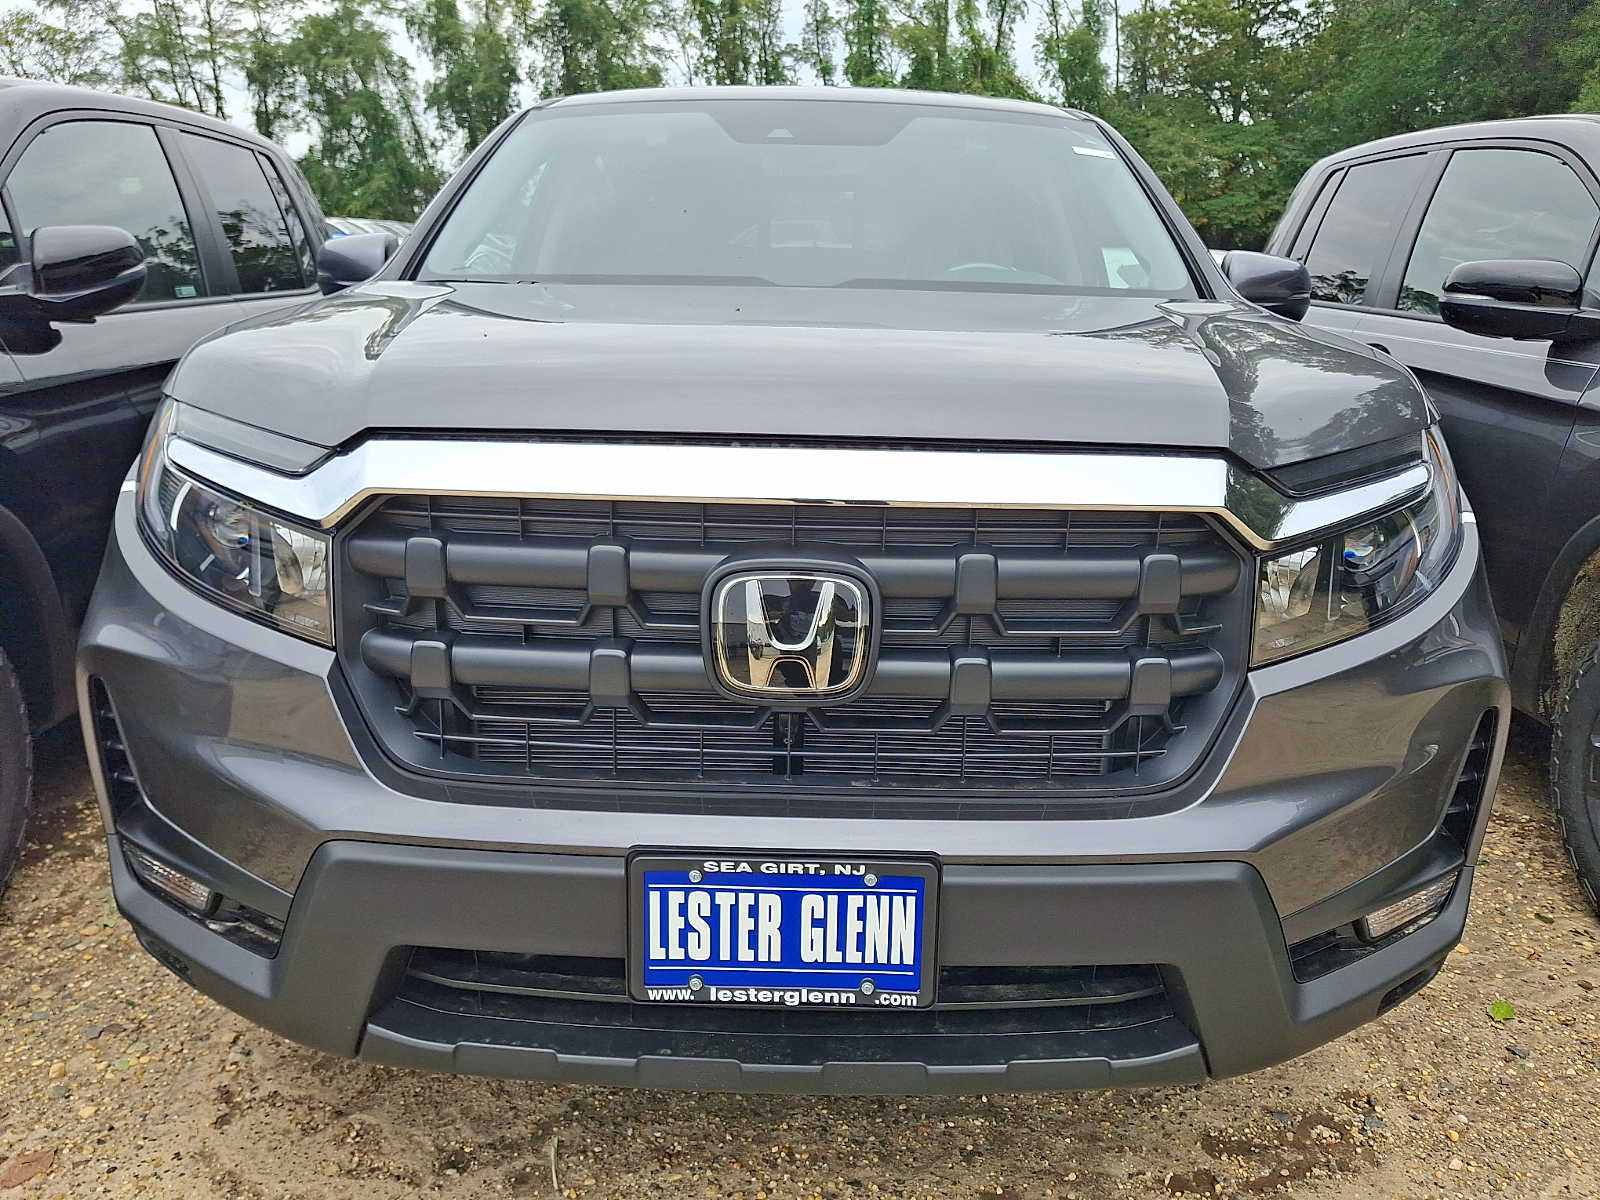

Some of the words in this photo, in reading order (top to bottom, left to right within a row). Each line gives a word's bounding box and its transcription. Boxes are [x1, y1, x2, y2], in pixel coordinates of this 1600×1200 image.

[703, 861, 752, 873] SEA
[760, 862, 826, 876] GIRT,
[834, 864, 866, 876] NJ
[649, 890, 782, 962] LESTER
[800, 893, 916, 965] GLENN
[648, 990, 695, 1001] www.
[710, 987, 856, 1006] lesterglenn
[874, 992, 917, 1006] .com
